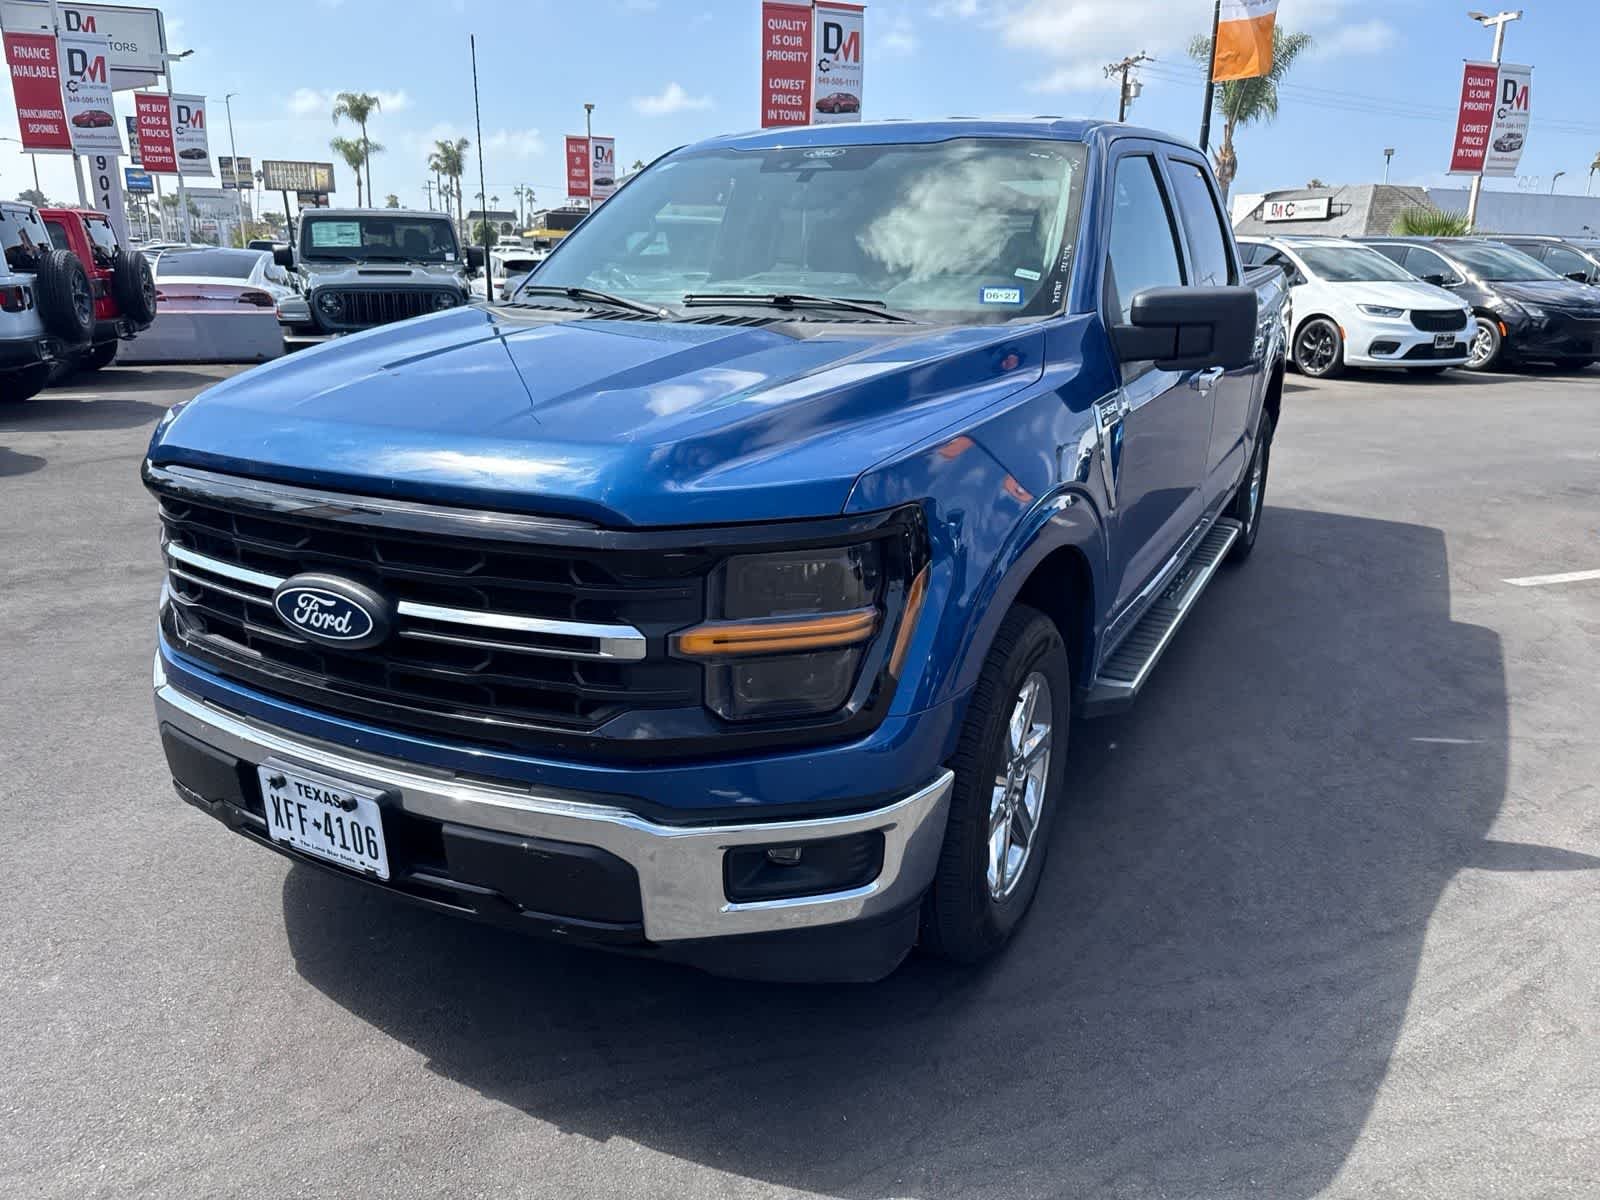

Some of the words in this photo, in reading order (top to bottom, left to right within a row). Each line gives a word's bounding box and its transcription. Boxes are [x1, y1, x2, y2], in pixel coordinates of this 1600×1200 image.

[768, 19, 807, 32] QUALITY
[108, 41, 138, 53] TORS
[772, 35, 781, 45] IS
[782, 36, 803, 47] OUR
[13, 46, 51, 60] FINANCE
[767, 50, 808, 63] PRIORITY
[12, 64, 57, 79] AVAILABLE
[769, 78, 806, 90] LOWEST
[1467, 77, 1495, 88] QUALITY
[772, 94, 803, 106] PRICES
[1469, 90, 1476, 99] IS
[1476, 90, 1491, 99] OUR
[139, 103, 151, 112] WE
[152, 104, 167, 113] BUY
[1463, 101, 1493, 113] PRIORITY
[141, 115, 161, 126] CARS
[162, 116, 168, 126] &
[768, 109, 778, 120] IN
[780, 109, 806, 121] TOWN
[141, 128, 170, 138] TRUCKS
[1462, 123, 1489, 134] LOWEST
[1461, 136, 1484, 146] PRICES
[1457, 148, 1465, 157] IN
[1464, 149, 1484, 158] TOWN
[144, 155, 174, 164] ACCEPTED
[293, 593, 352, 634] Ford
[294, 782, 342, 809] TEXAS
